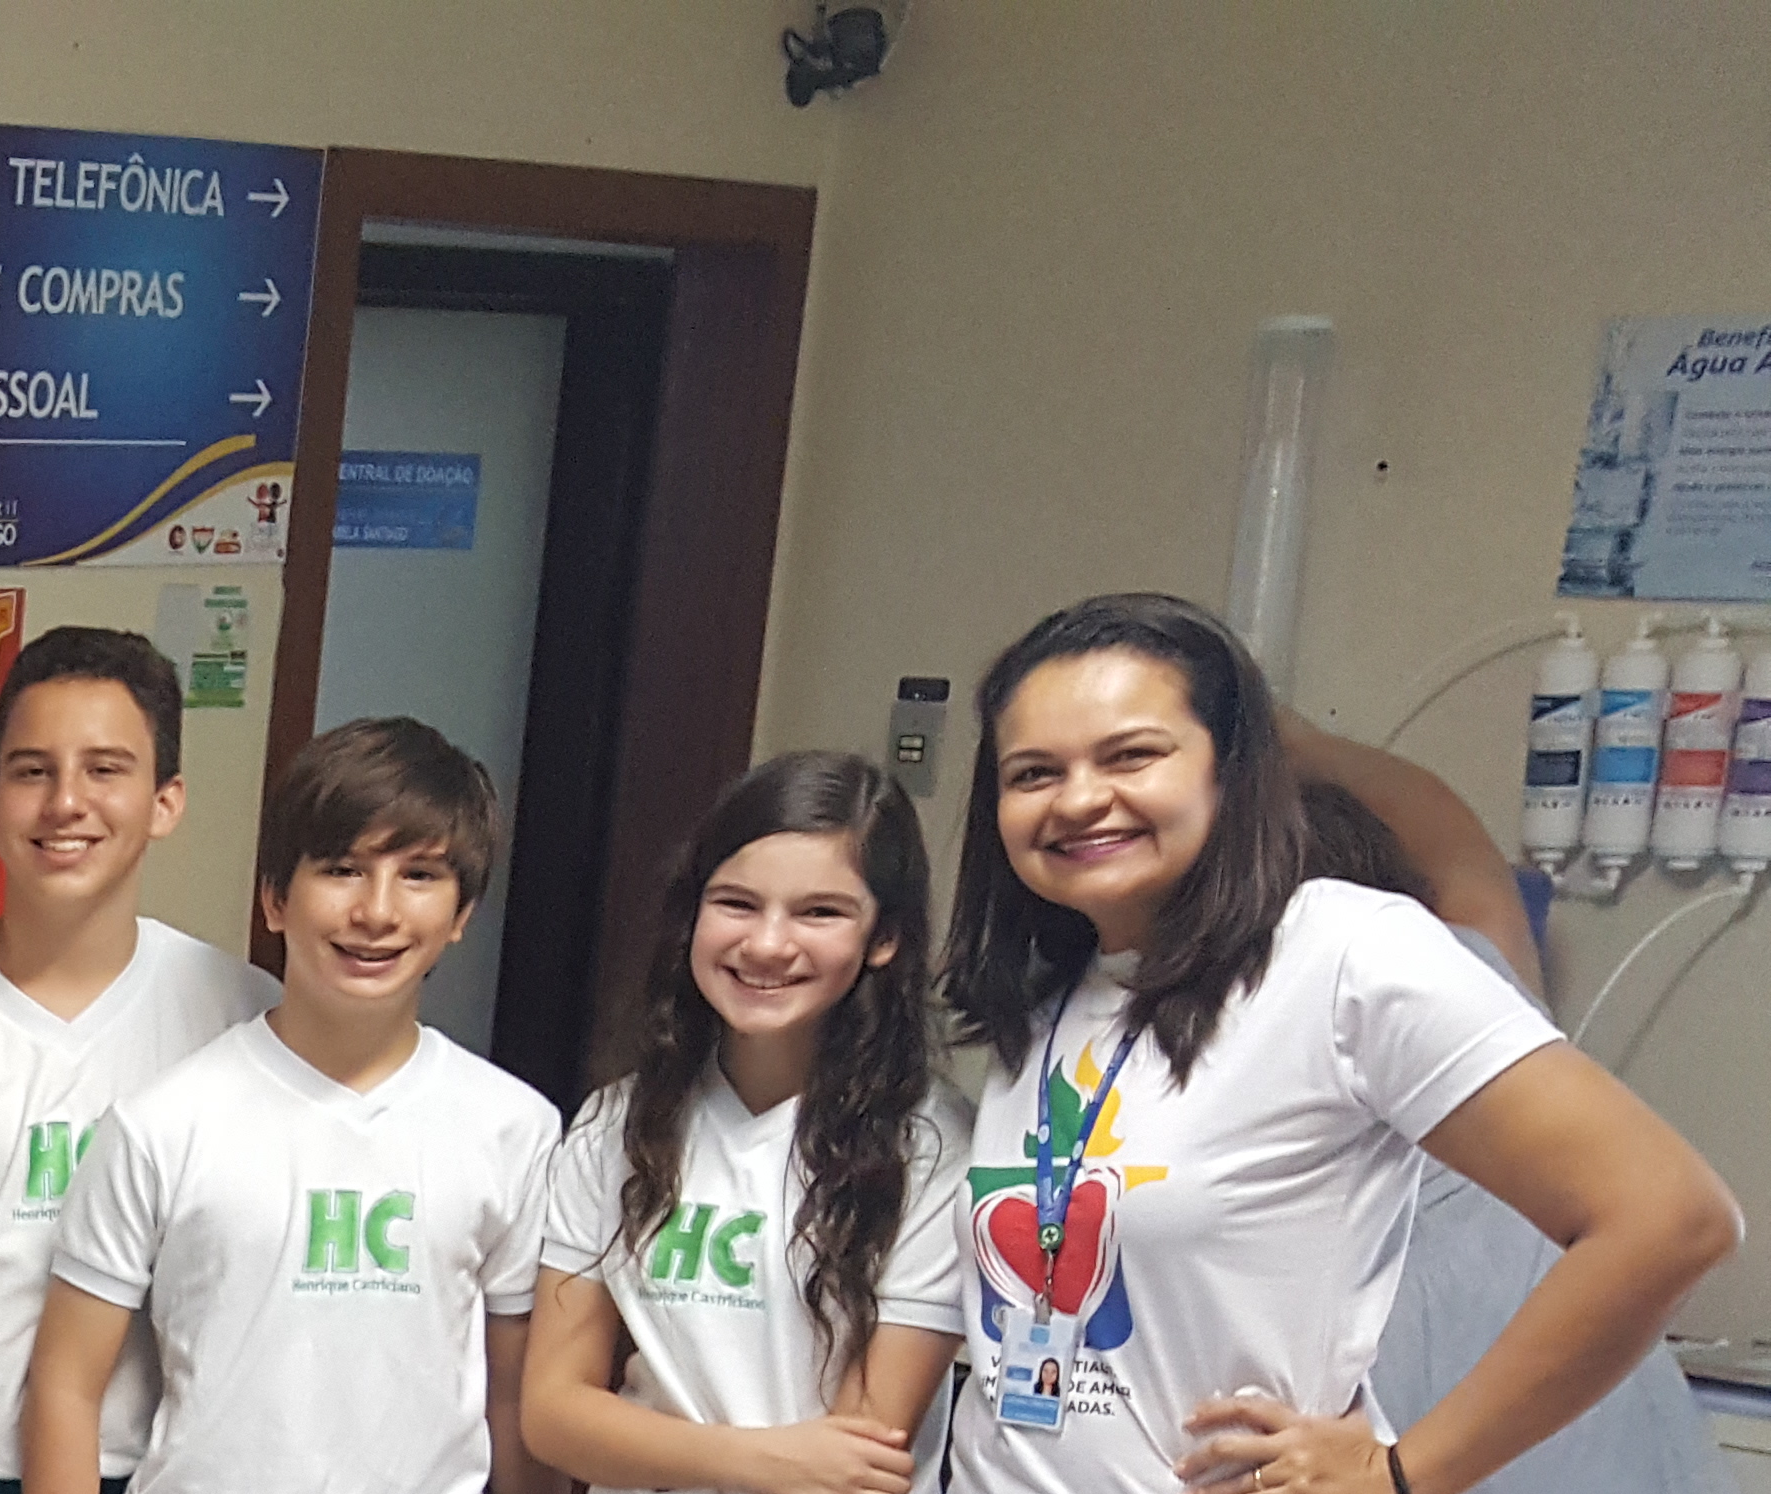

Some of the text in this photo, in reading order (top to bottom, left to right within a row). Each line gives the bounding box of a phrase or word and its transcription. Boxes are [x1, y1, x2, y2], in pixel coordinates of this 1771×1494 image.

[9, 153, 226, 218] TELEFÔNICA
[19, 265, 186, 320] COMPRAS
[1665, 345, 1749, 383] Água
[338, 462, 390, 482] ENTRAL
[12, 1207, 62, 1224] Henriqu
[301, 1187, 417, 1276] HC
[649, 1201, 769, 1289] HC
[290, 1278, 422, 1296] Henrique Castriciano
[690, 1289, 767, 1311] Castriciano
